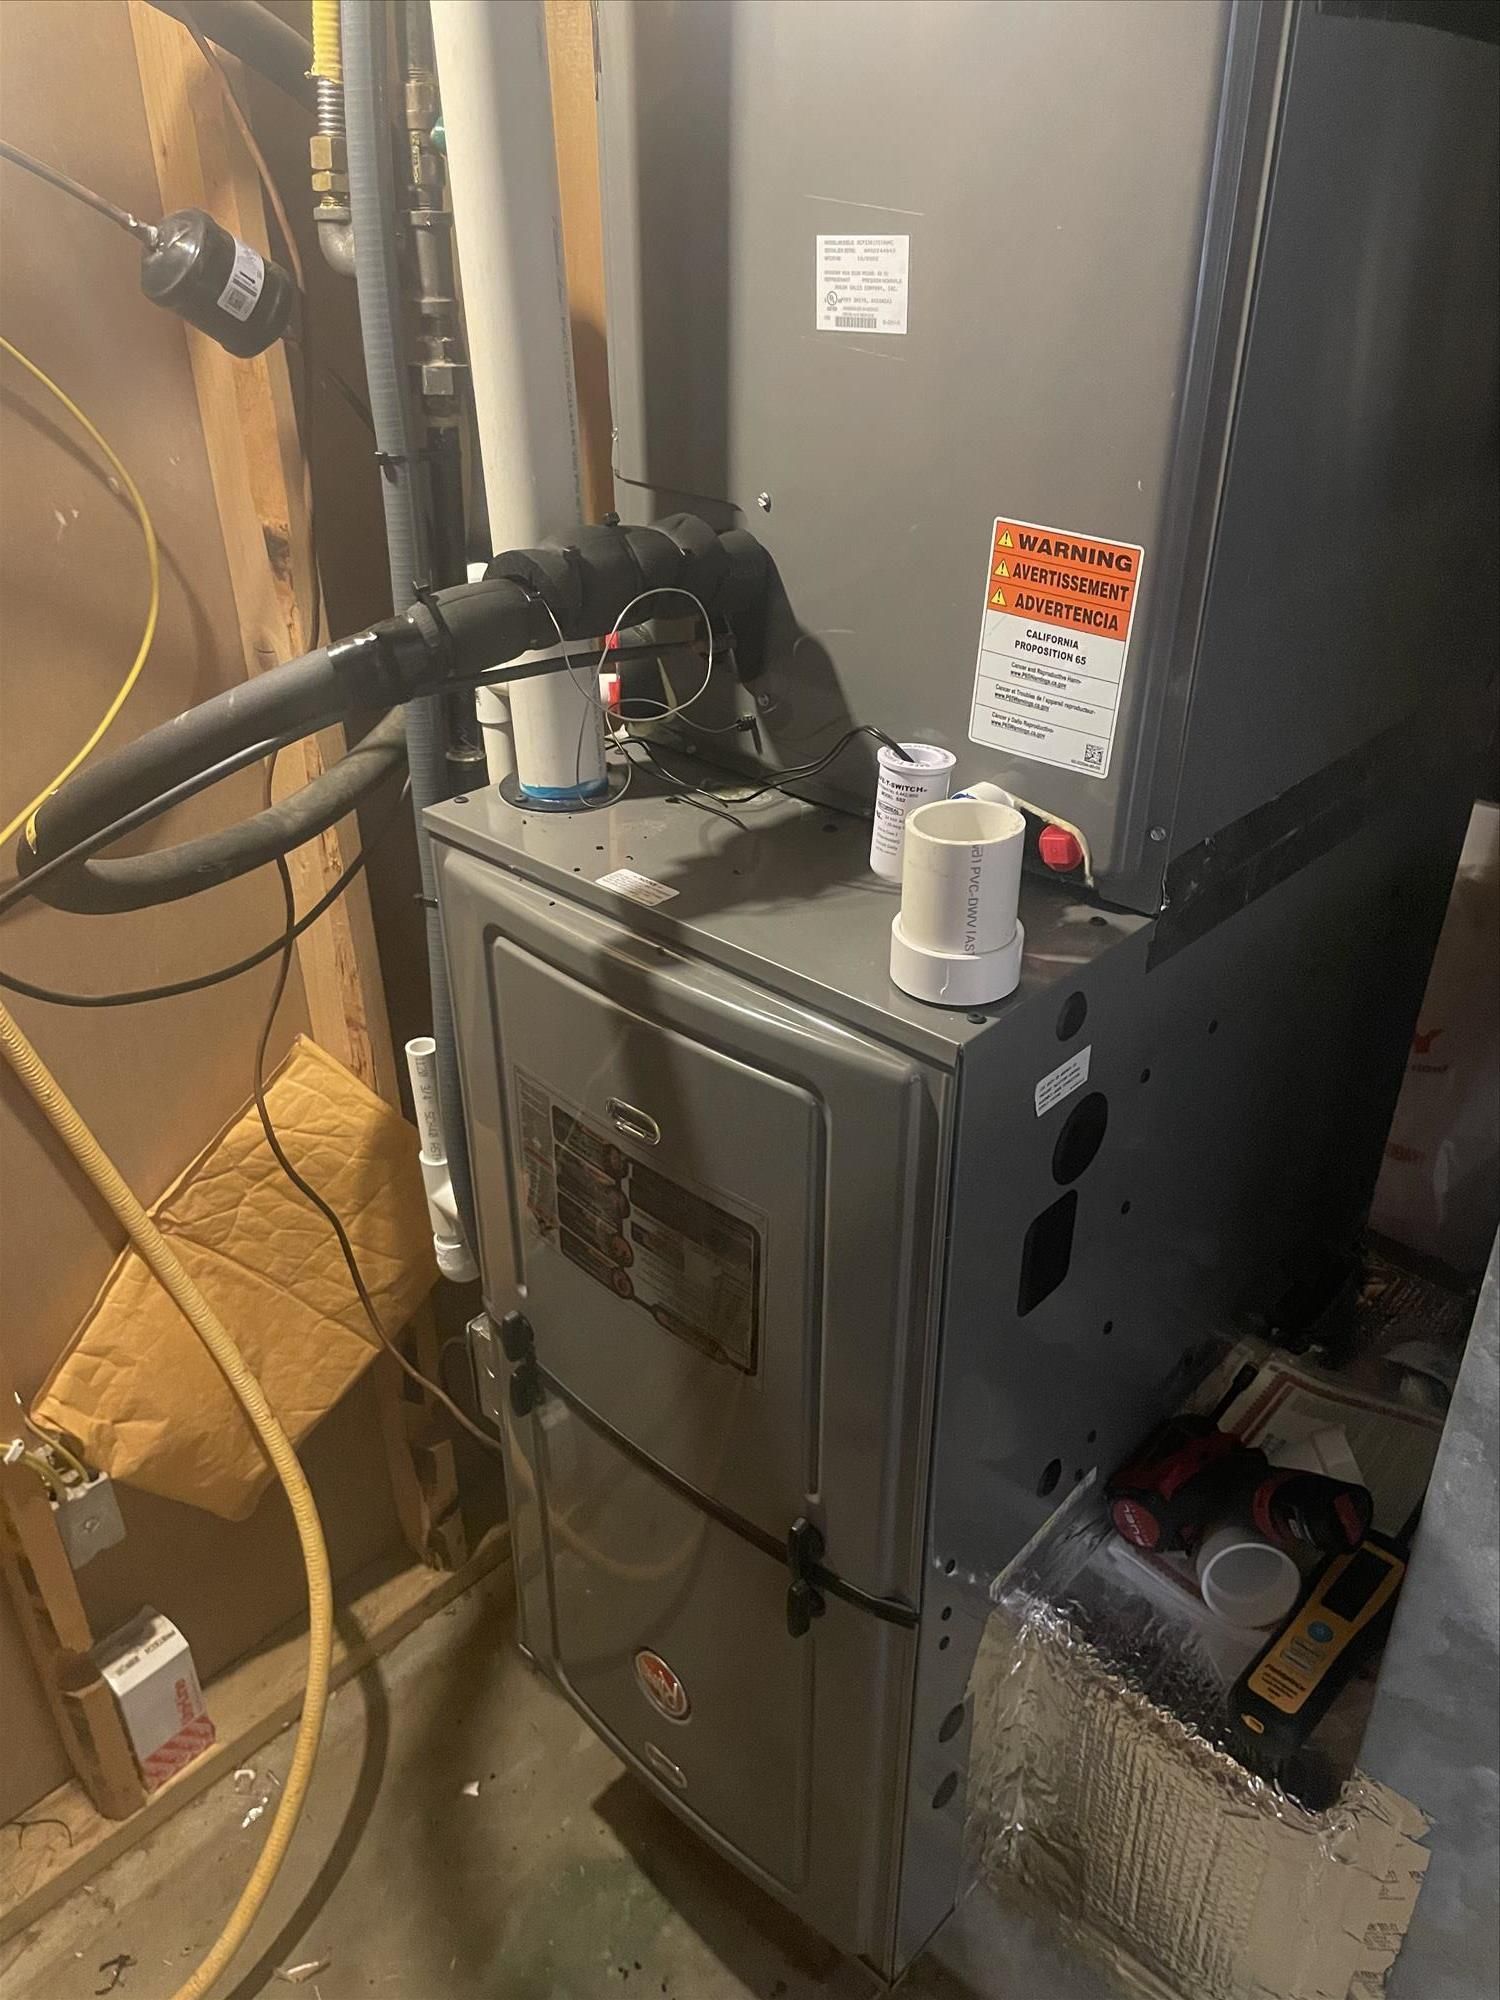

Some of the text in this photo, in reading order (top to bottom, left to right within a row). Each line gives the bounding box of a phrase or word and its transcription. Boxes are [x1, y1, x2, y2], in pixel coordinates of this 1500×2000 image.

[1018, 533, 1132, 572] WARNING
[1012, 562, 1130, 602] AVERTISSEMENT
[1014, 593, 1119, 631] ADVERTENCIA
[1014, 639, 1087, 666] PROPOSITION 65
[1026, 629, 1079, 650] CALIFORNIA
[968, 866, 982, 928] PVC-DWV
